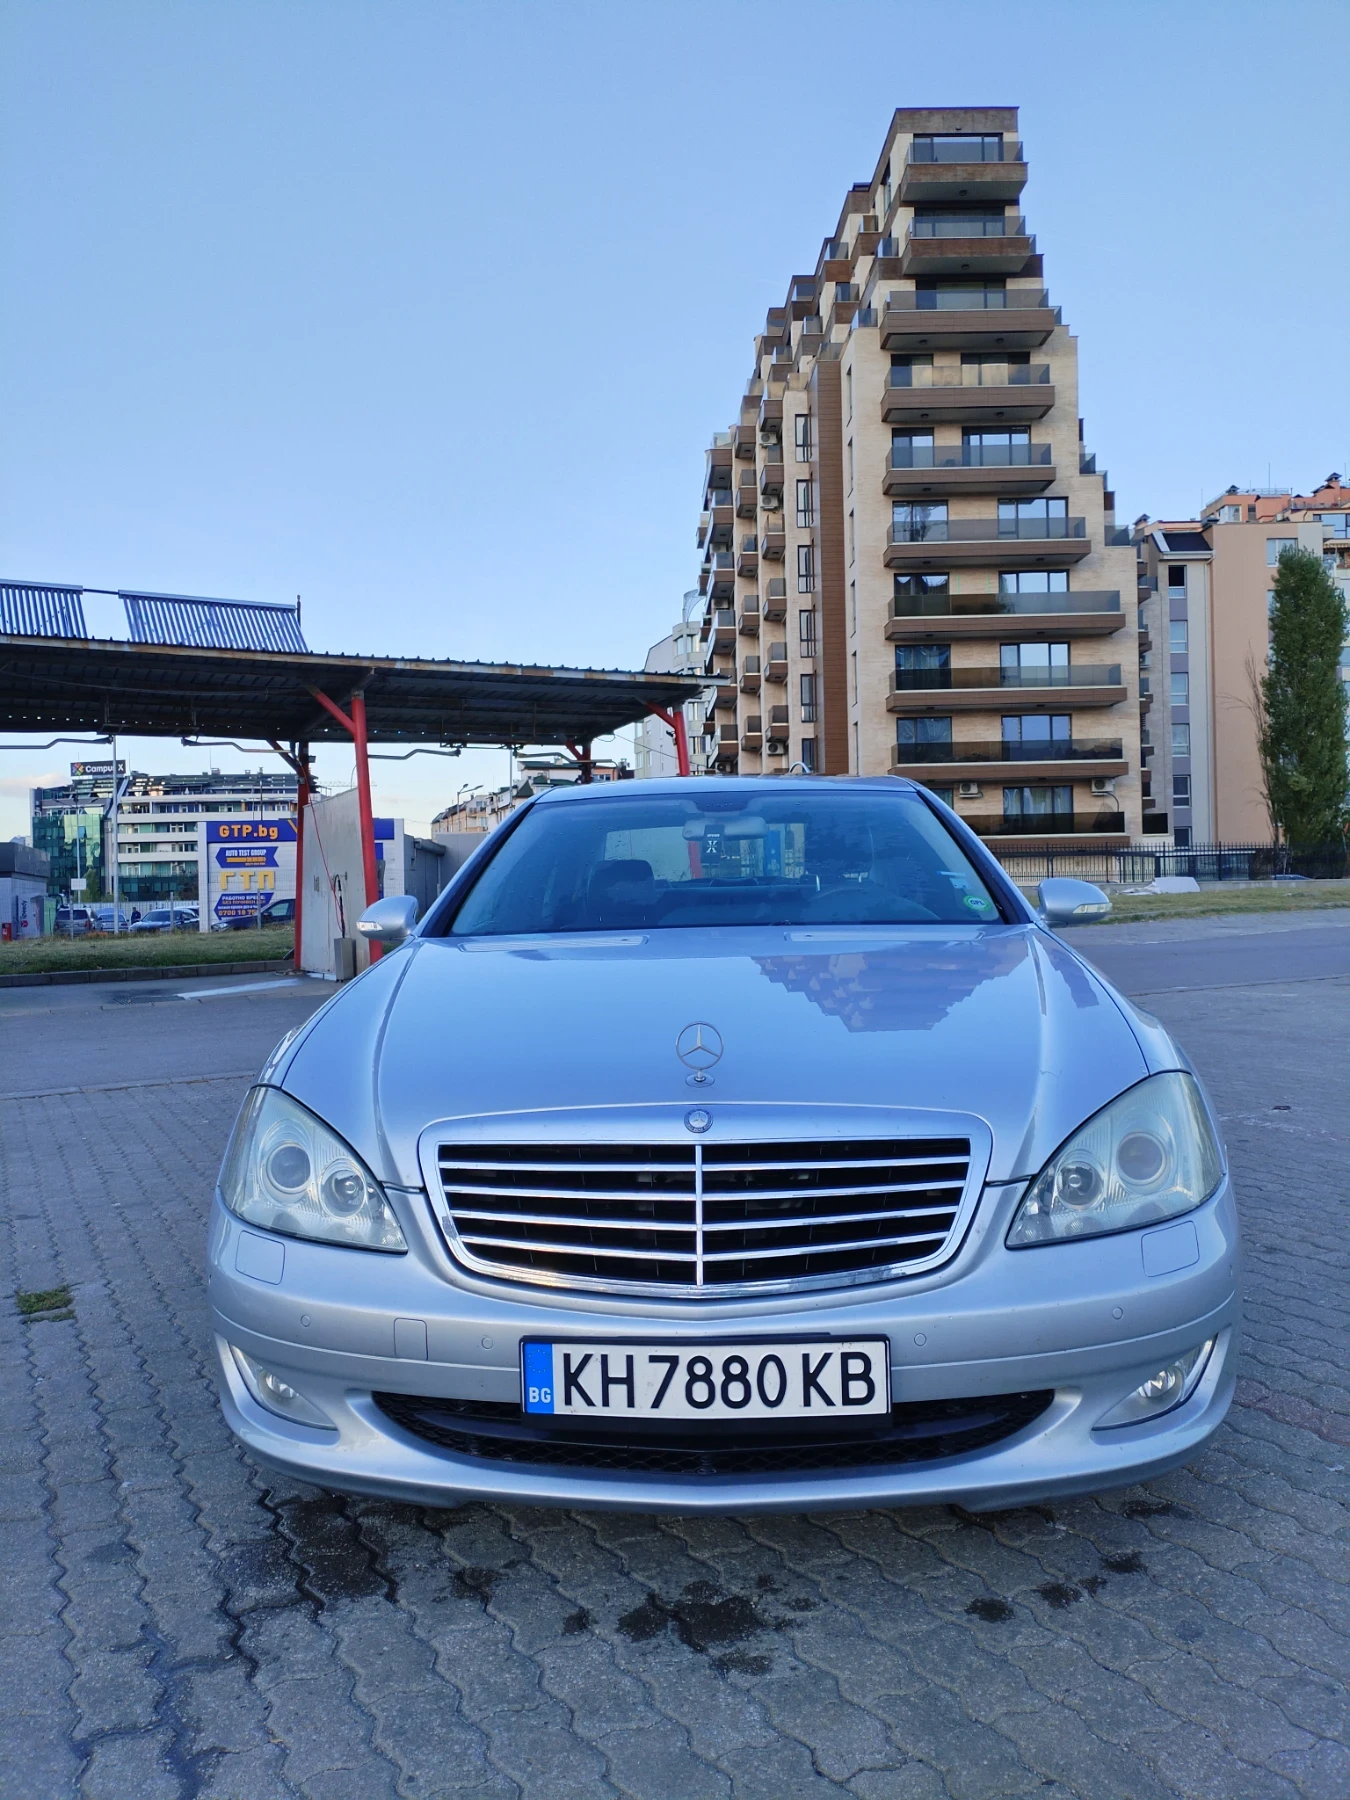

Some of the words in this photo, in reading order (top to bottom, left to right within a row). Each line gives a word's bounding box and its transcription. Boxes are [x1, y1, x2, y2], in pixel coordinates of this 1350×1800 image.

[85, 765, 115, 774] Campu
[219, 824, 279, 840] GTP.bg
[221, 871, 275, 890] ГТП
[528, 1387, 551, 1404] BG
